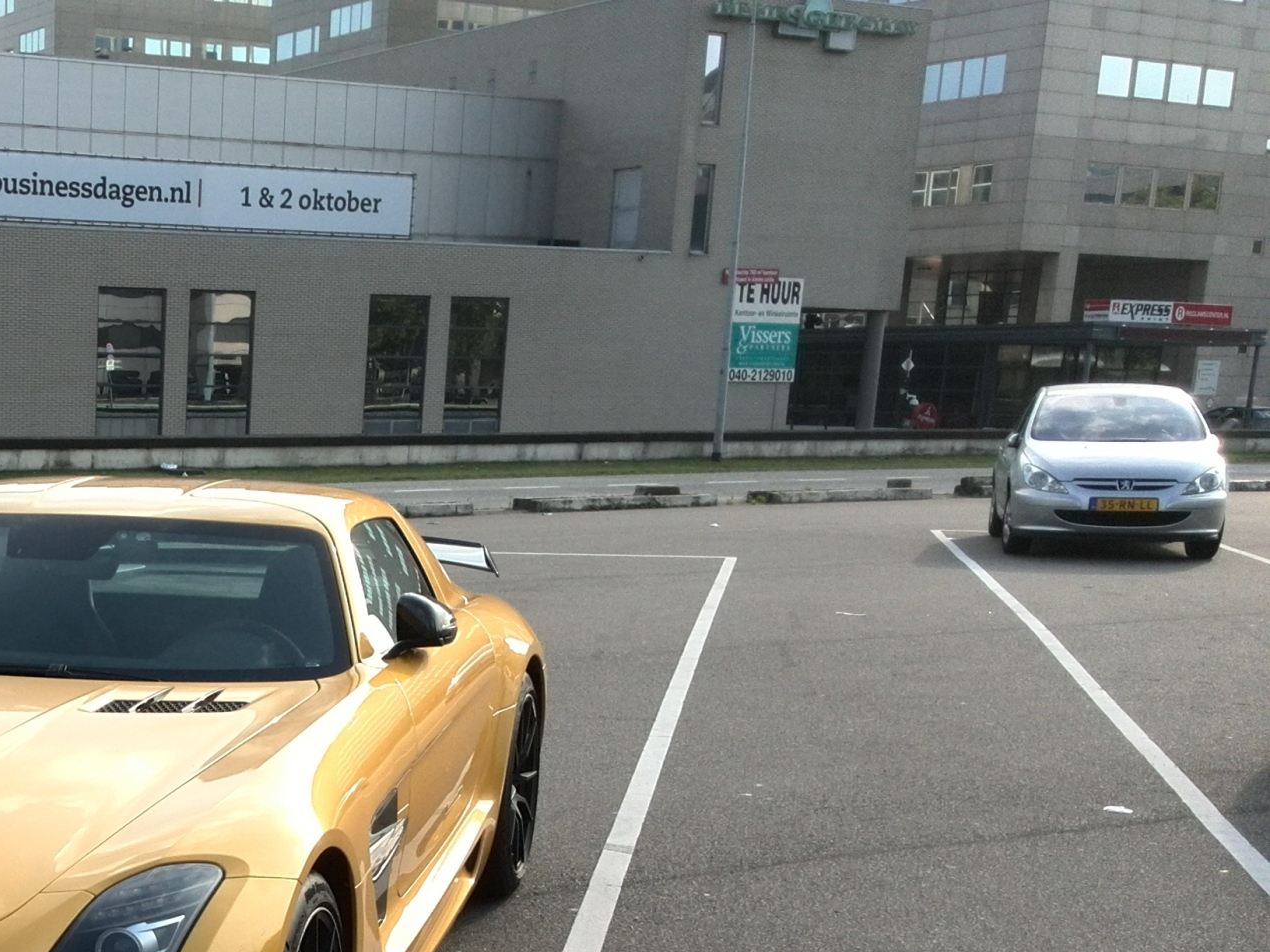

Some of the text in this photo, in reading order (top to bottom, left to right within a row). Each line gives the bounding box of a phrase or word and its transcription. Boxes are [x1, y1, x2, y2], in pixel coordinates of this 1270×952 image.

[240, 186, 251, 207] 1
[258, 187, 274, 208] &
[280, 188, 292, 209] 2
[299, 189, 381, 213] oktober
[738, 281, 801, 305] TE HUUR
[1121, 302, 1172, 320] EXPRESS
[739, 325, 792, 344] Vissers
[729, 369, 793, 381] 040-2129010
